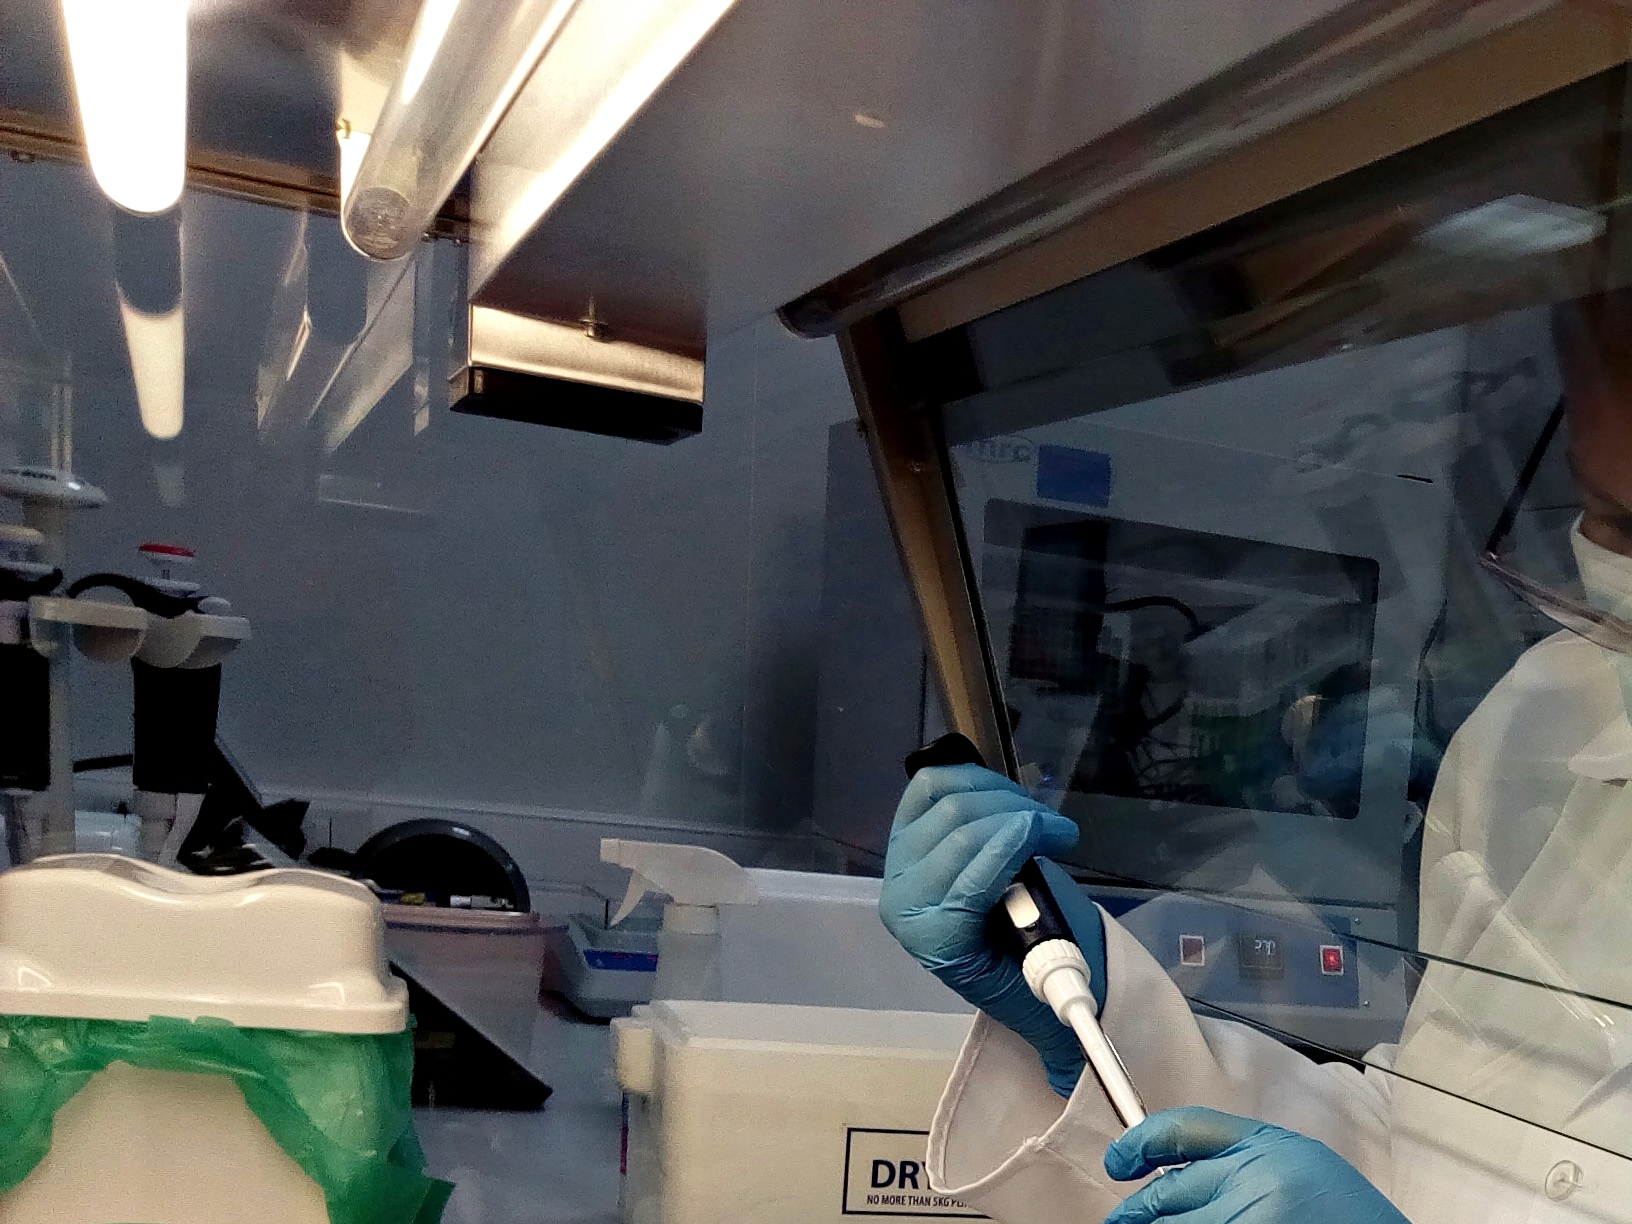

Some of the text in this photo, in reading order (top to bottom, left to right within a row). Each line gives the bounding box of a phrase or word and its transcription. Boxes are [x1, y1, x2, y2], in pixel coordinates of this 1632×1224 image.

[866, 1194, 879, 1205] NO
[881, 1194, 906, 1206] MORE
[908, 1195, 931, 1207] THAN
